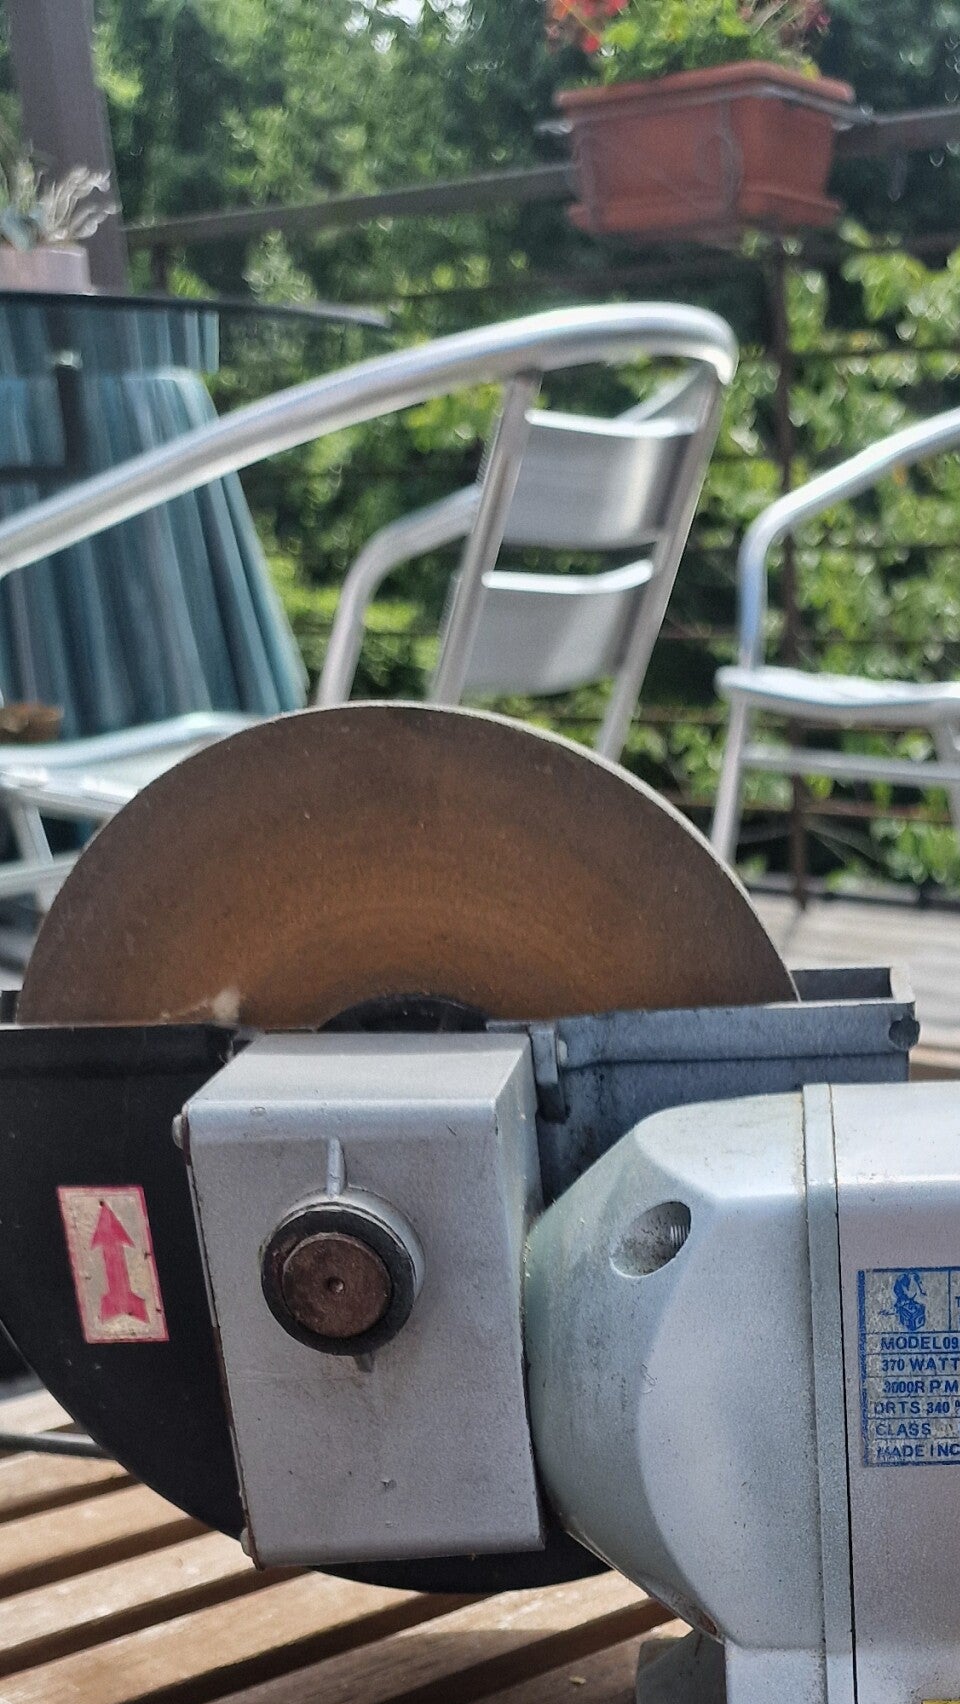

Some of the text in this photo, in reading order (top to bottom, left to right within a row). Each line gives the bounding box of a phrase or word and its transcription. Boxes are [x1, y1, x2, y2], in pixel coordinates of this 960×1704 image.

[881, 1357, 960, 1372] 370 WATT
[926, 1401, 950, 1414] 340
[876, 1422, 931, 1436] CLASS
[877, 1444, 925, 1458] MADE
